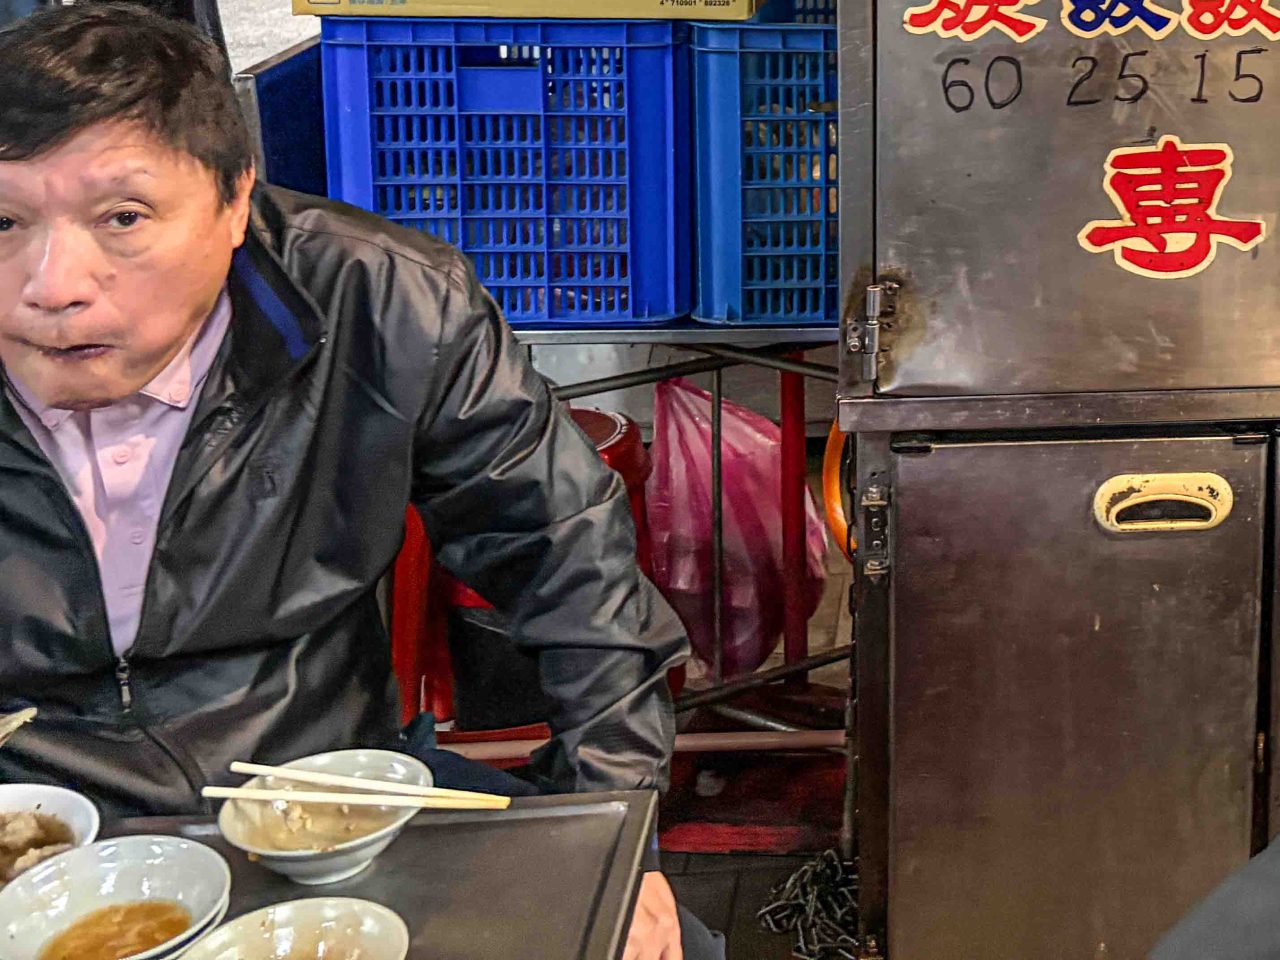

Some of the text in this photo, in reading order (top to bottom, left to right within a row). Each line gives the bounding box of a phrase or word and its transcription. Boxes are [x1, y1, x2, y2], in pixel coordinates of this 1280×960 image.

[942, 55, 1023, 113] 60
[1066, 50, 1149, 107] 25
[1190, 48, 1268, 104] 15
